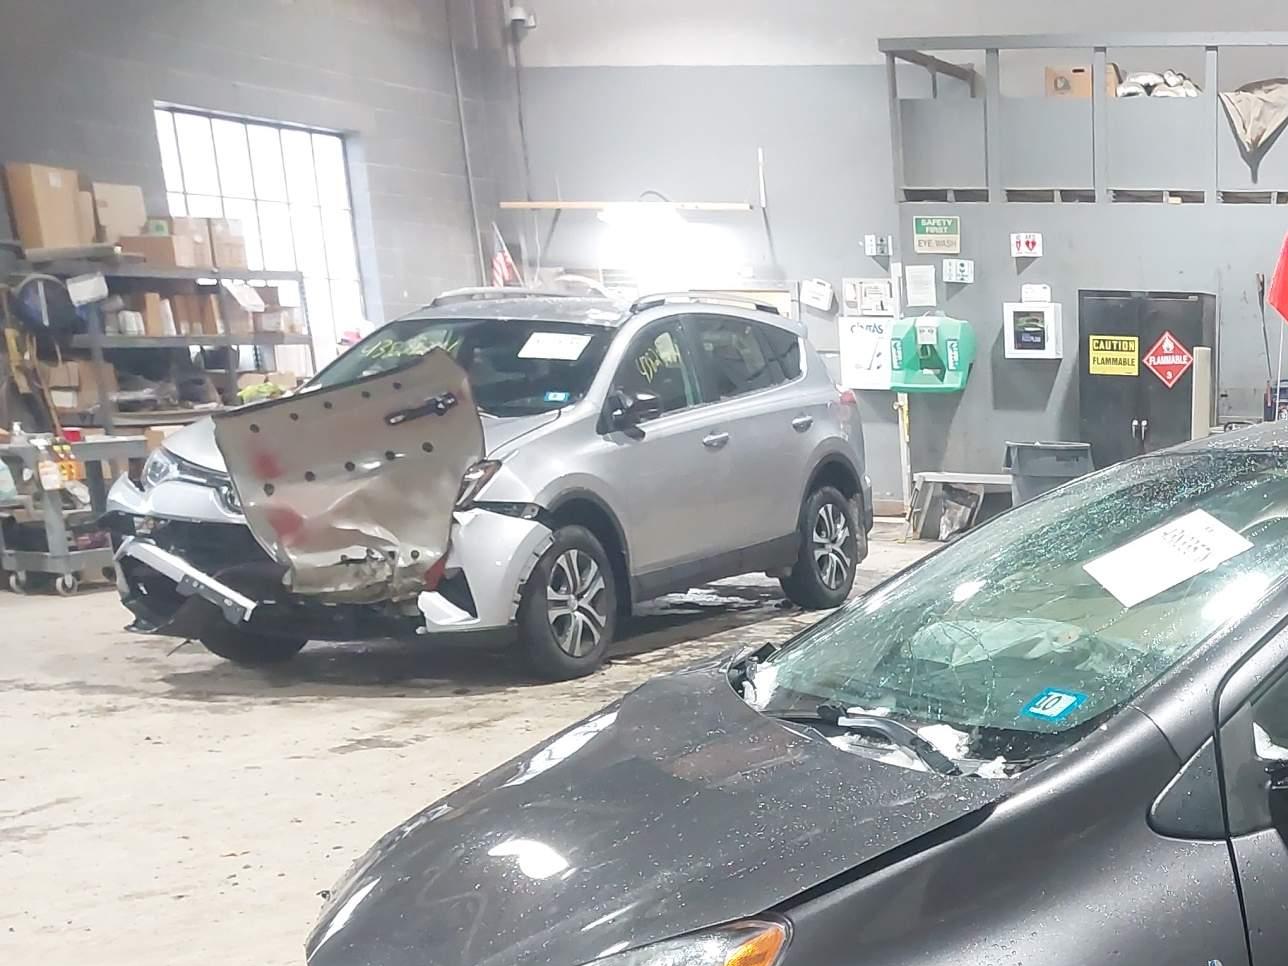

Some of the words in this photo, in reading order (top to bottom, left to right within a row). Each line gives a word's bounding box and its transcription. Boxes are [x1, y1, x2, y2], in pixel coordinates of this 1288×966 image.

[918, 240, 932, 248] EYE
[1093, 340, 1135, 351] CAUTION
[1093, 356, 1135, 367] FLAMMABLE
[1148, 354, 1188, 366] FLAMMABLE
[1165, 371, 1173, 380] 3
[1033, 694, 1063, 711] 10
